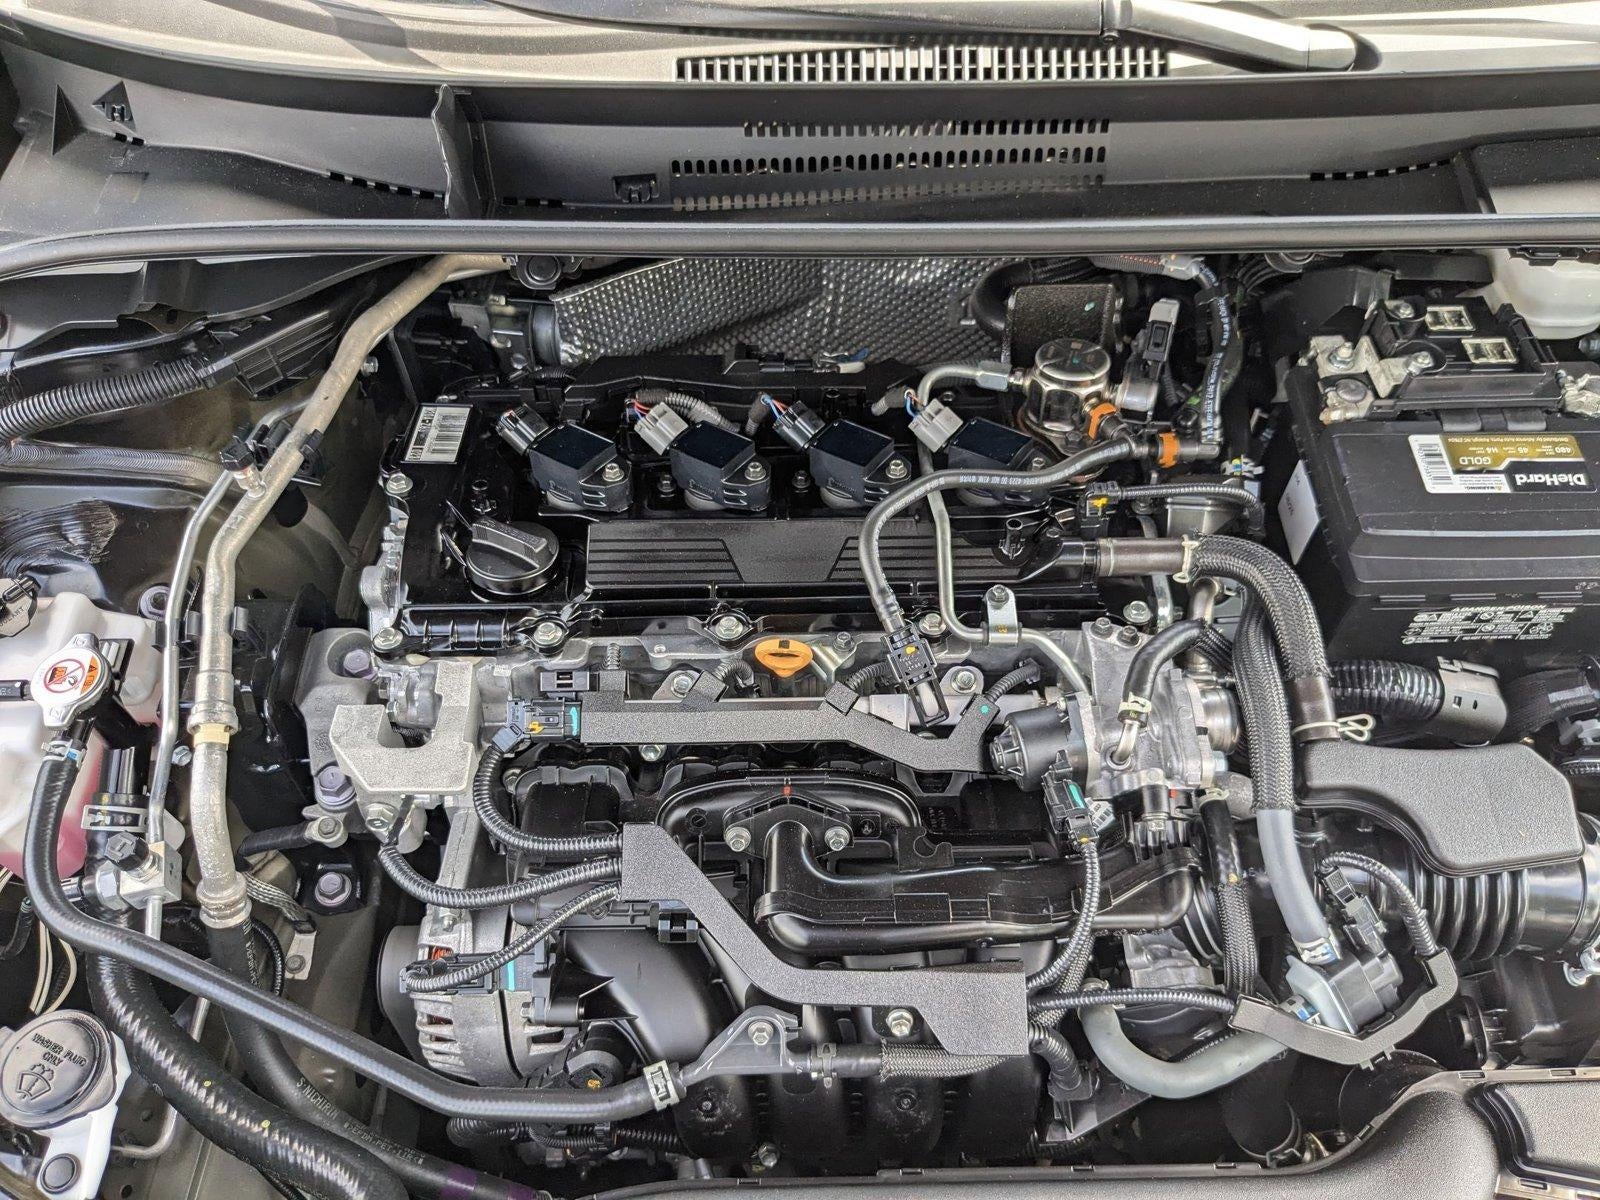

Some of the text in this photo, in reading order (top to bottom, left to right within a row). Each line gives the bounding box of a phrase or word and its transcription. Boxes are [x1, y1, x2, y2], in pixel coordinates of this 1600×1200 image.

[1459, 456, 1491, 465] GOLD
[1514, 473, 1587, 486] DieHard
[31, 1033, 88, 1067] WASHER FLUID
[42, 1052, 64, 1067] ONLY
